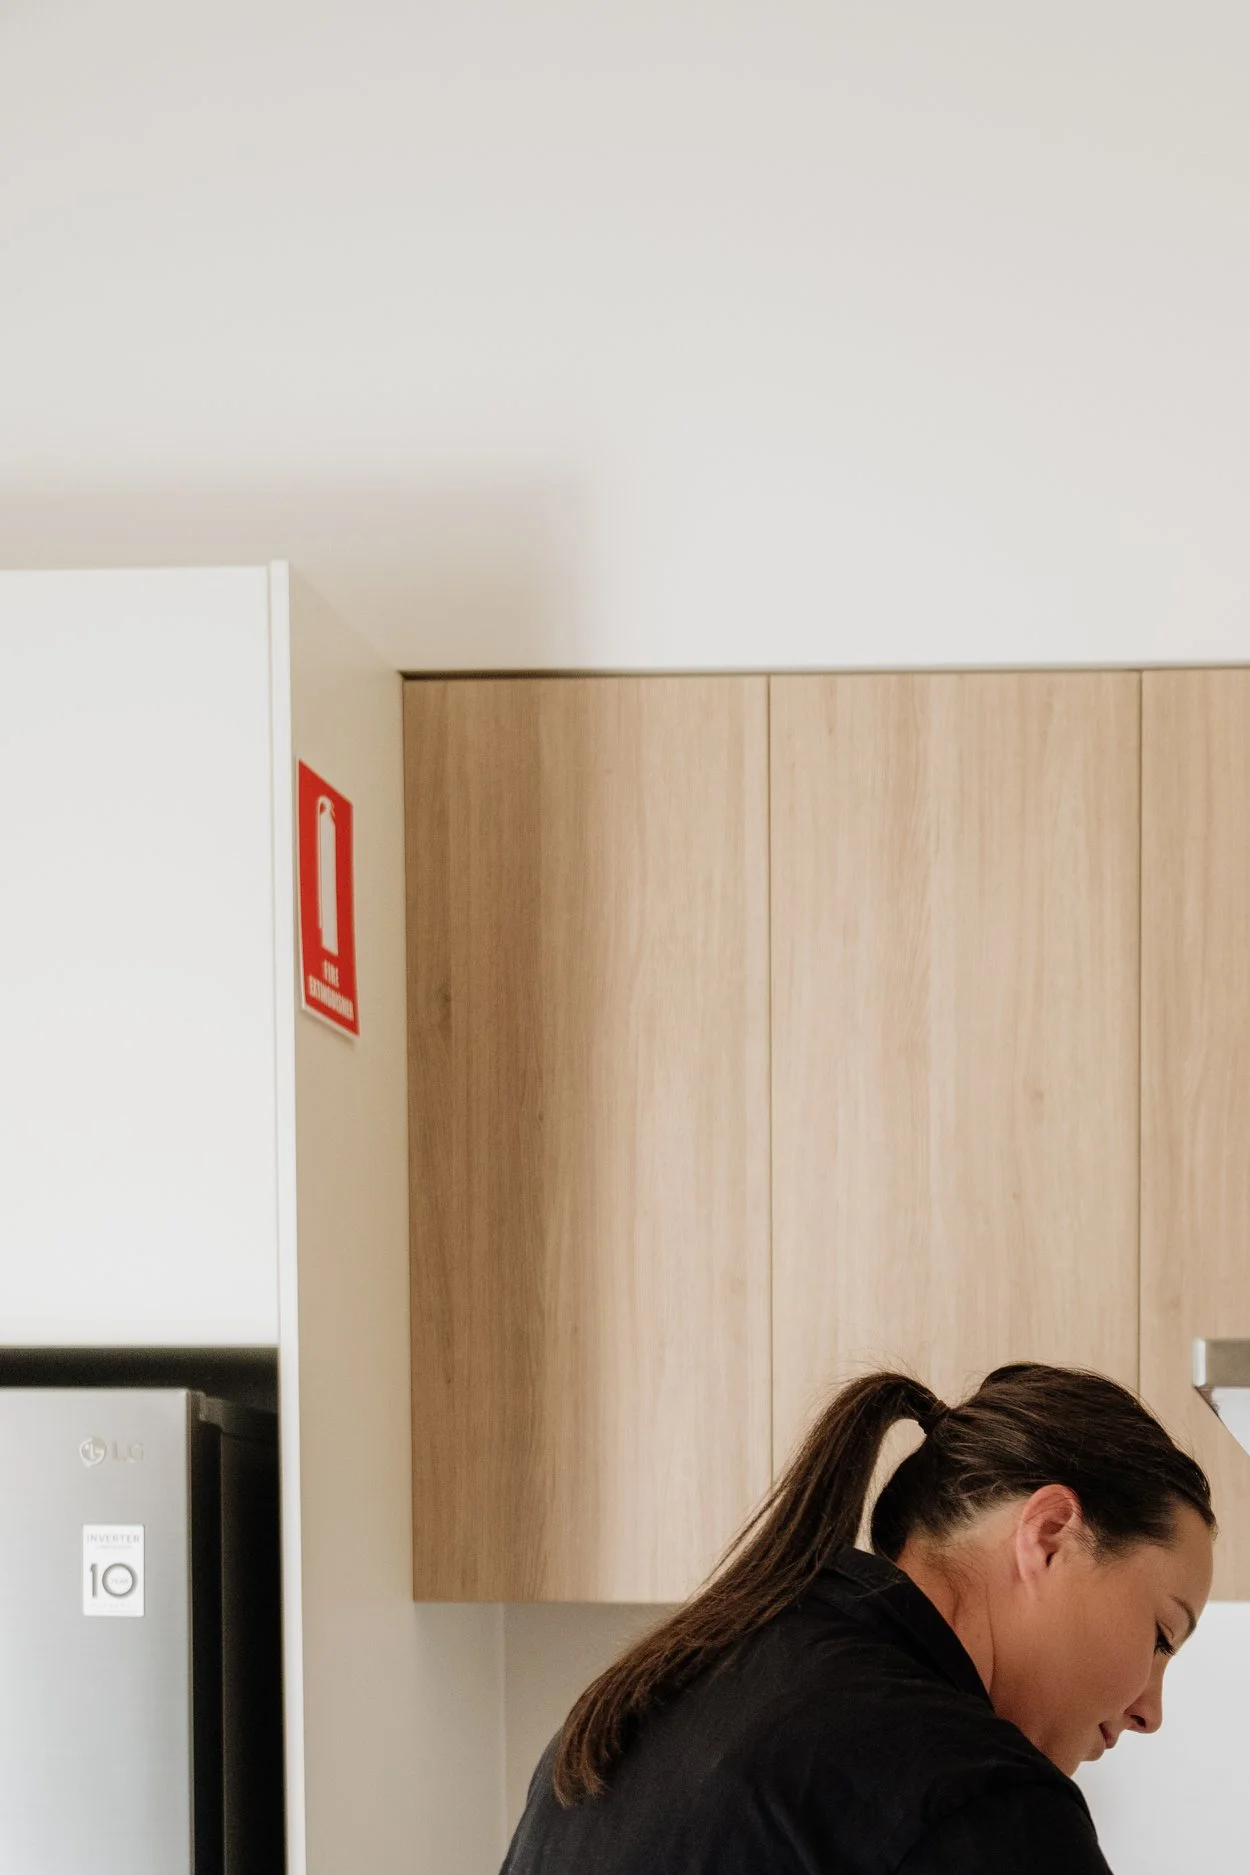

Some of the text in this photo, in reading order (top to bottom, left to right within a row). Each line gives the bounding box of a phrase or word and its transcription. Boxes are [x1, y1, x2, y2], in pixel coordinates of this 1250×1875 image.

[323, 959, 340, 988] FIRE
[309, 974, 355, 1021] EXTINGUISHER
[112, 1440, 144, 1462] LG
[87, 1534, 140, 1543] INVERTER
[89, 1562, 138, 1598] 10
